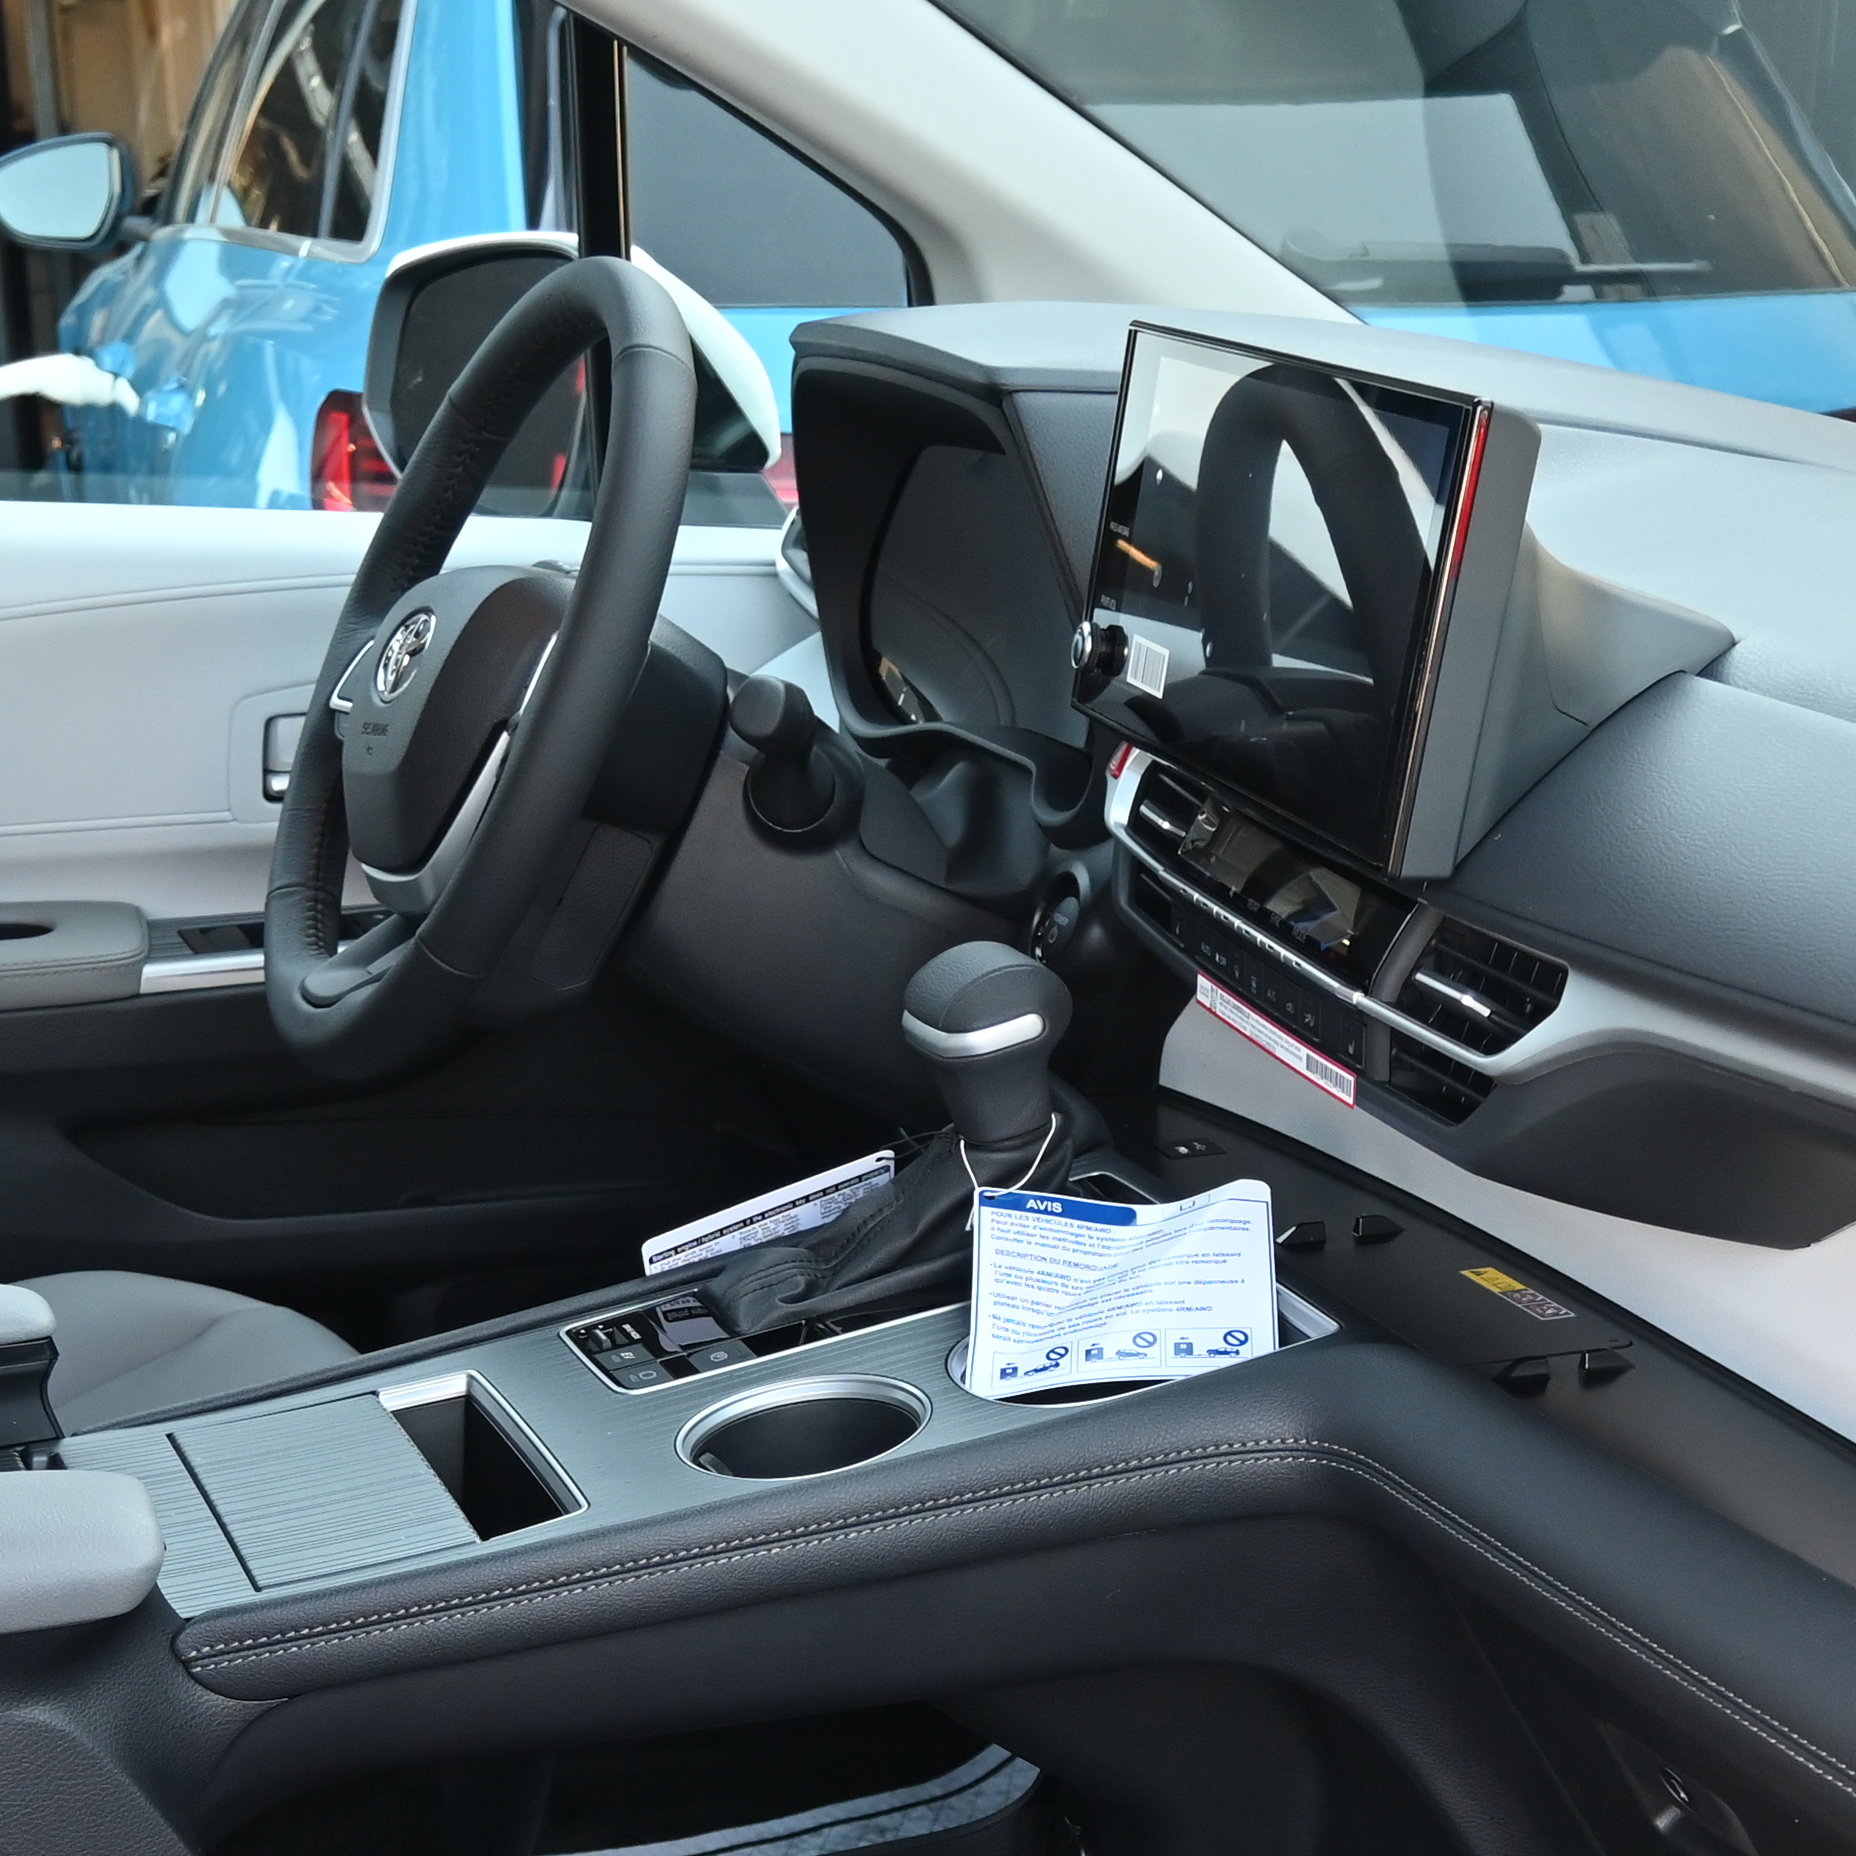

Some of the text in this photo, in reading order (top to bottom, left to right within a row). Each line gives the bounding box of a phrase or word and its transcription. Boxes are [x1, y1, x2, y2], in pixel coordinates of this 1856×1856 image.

[1025, 1199, 1063, 1213] AVIS
[995, 1249, 1048, 1263] DESCRIPTION
[1049, 1256, 1061, 1265] DU
